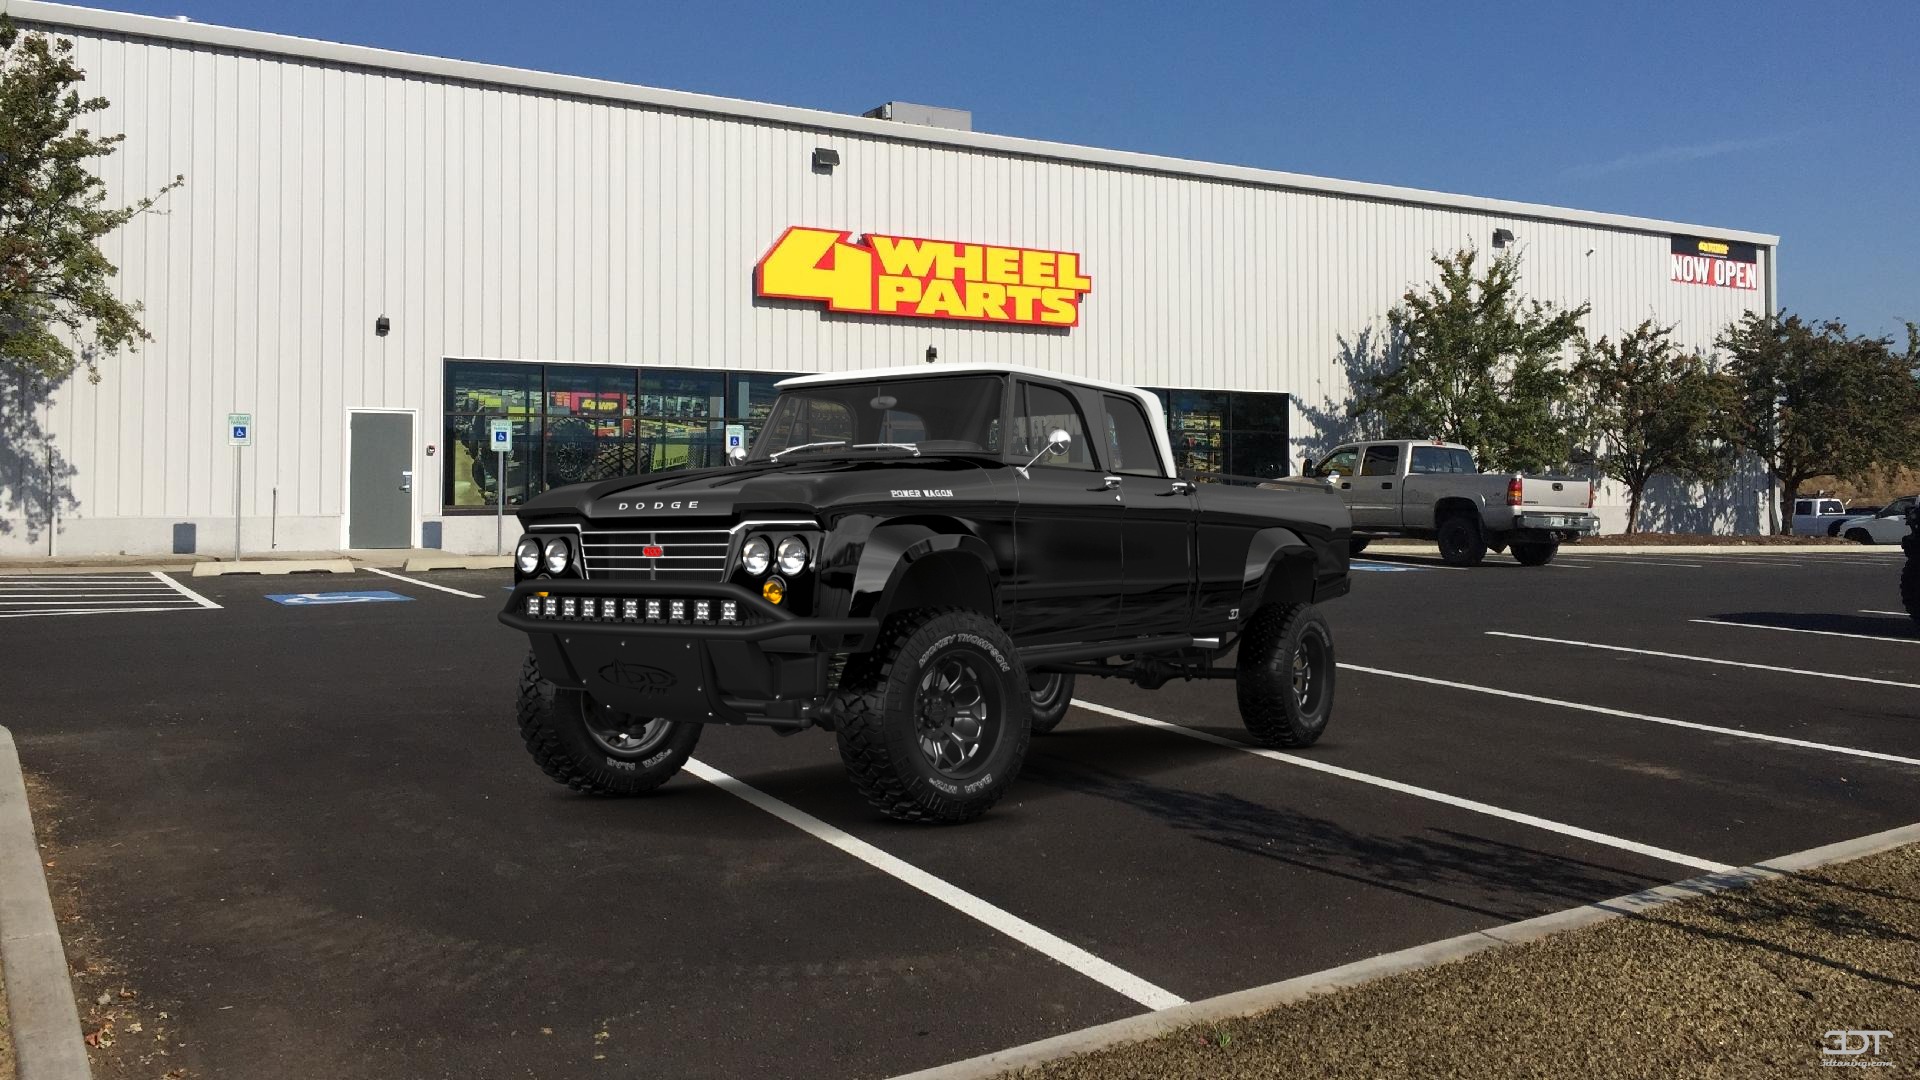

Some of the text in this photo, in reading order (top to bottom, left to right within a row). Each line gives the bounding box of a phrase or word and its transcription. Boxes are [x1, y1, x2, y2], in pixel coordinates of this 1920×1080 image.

[763, 229, 1091, 311] 4 WHEEL
[1671, 254, 1757, 288] NOW OPEN
[878, 275, 1077, 324] PARTS
[618, 501, 699, 511] DODGE
[890, 489, 954, 498] POWER WAGON
[957, 633, 1011, 673] THOMPSON
